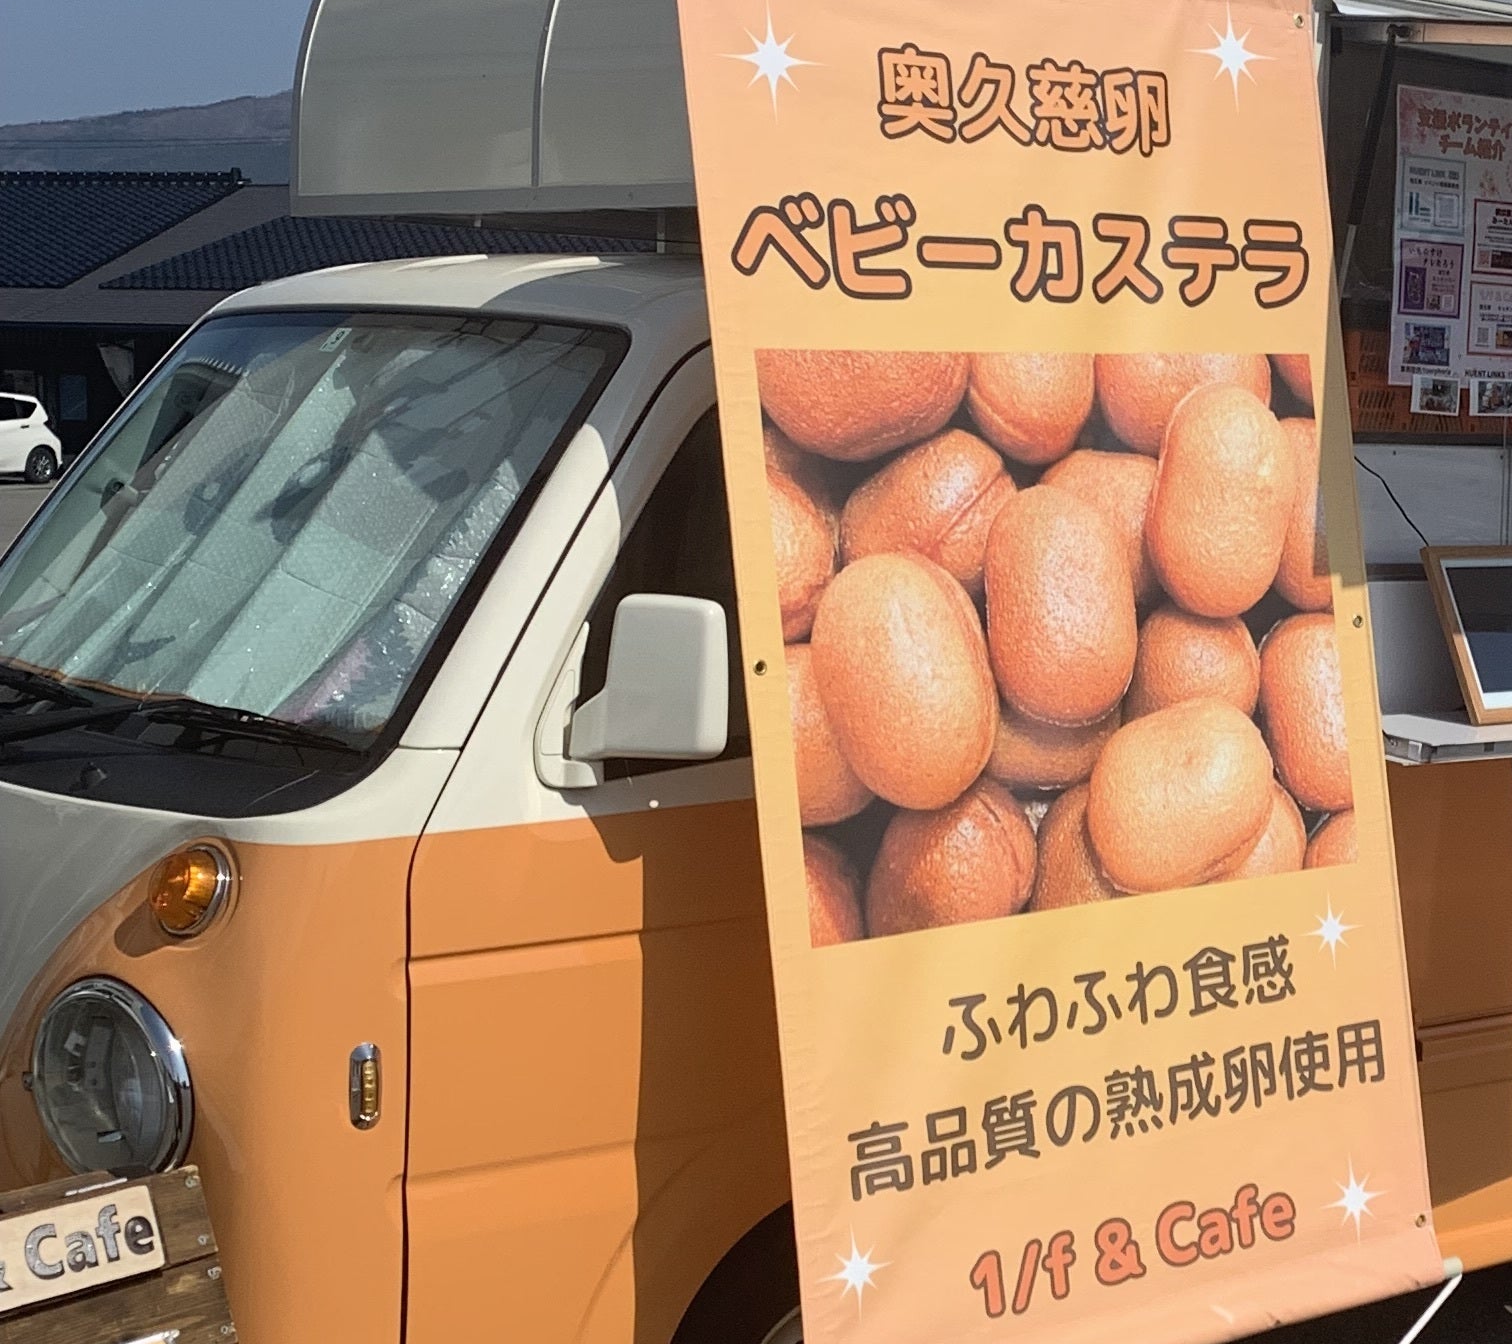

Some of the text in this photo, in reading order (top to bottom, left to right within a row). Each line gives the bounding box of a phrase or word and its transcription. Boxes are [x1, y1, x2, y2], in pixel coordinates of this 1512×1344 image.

[877, 42, 1172, 158] 奥久慈卵
[731, 191, 1311, 309] ベビーカステラ
[942, 934, 1298, 1061] ふわふわ食感
[846, 1018, 1387, 1202] 高品質の熟成卵使用
[24, 1203, 156, 1281] Cafe
[968, 1183, 1297, 1319] 1/f & Cafe
